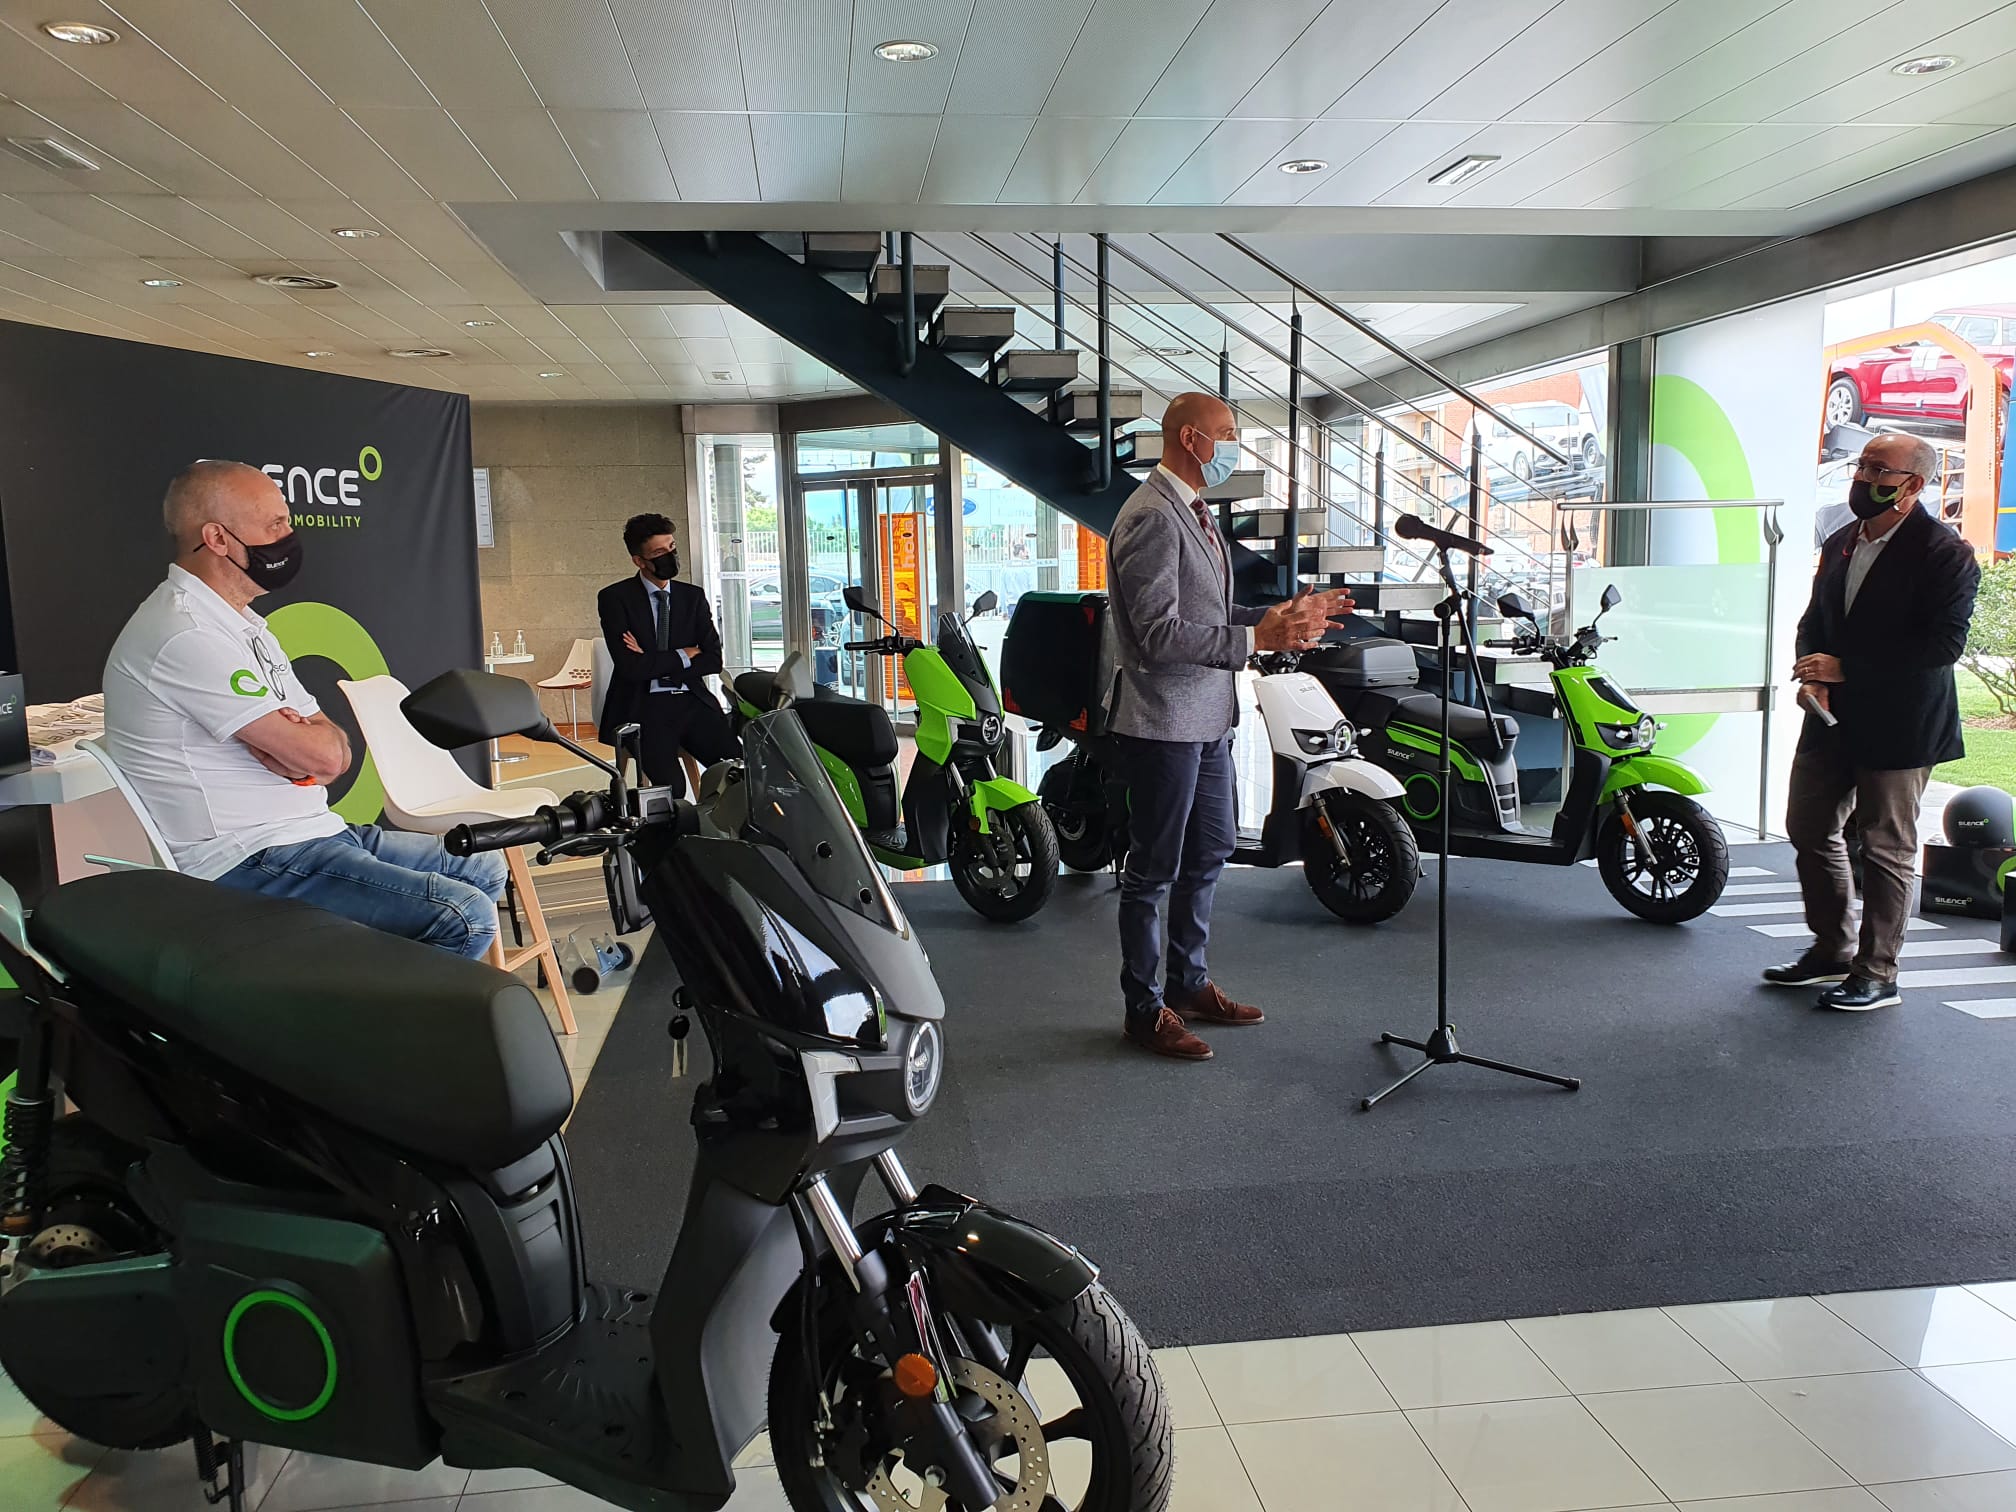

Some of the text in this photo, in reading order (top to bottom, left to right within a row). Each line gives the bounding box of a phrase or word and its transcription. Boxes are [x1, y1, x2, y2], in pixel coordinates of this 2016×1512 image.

[195, 459, 361, 506] ENCE
[1387, 748, 1410, 760] SILENCE
[1935, 897, 1967, 905] SILENCE
